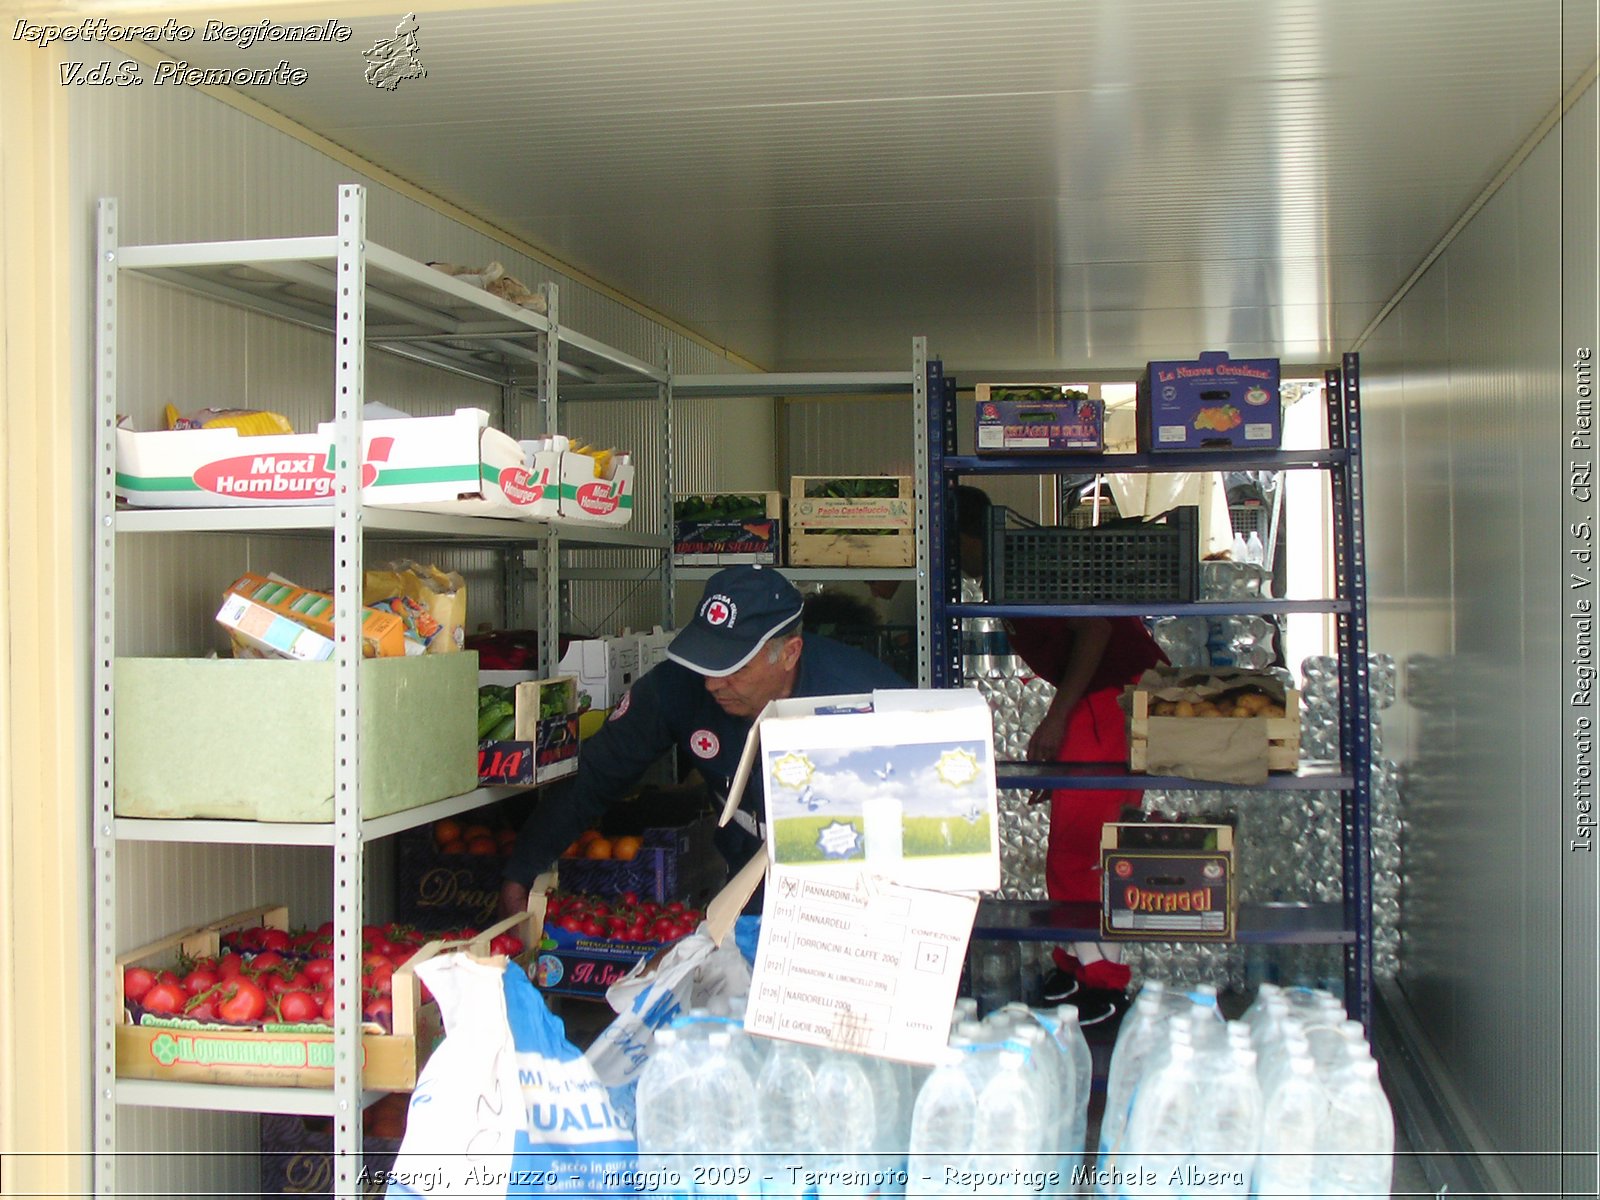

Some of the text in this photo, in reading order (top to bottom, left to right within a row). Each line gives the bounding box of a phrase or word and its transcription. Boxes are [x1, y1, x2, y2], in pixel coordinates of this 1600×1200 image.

[251, 454, 315, 475] Maxi
[216, 475, 335, 496] Hamburg
[581, 495, 615, 514] Hamburger
[818, 506, 840, 515] Paolo
[478, 750, 524, 778] LIA
[415, 867, 500, 926] Drag
[805, 884, 850, 901] PANNARDINI
[1124, 884, 1212, 913] ORTAGGI
[801, 912, 850, 930] PANNARDELLI
[911, 928, 962, 942] CONFEZIONI
[796, 936, 842, 954] TORRONCINI
[844, 946, 852, 956] AL
[882, 953, 899, 967] 200g
[925, 951, 940, 964] 12
[786, 990, 852, 1013] NARDORELLI 200g
[781, 1018, 790, 1029] LE
[814, 1024, 832, 1038] 200g
[905, 1020, 934, 1031] LOTTO
[308, 1041, 335, 1068] BO
[526, 1102, 622, 1133] UALI
